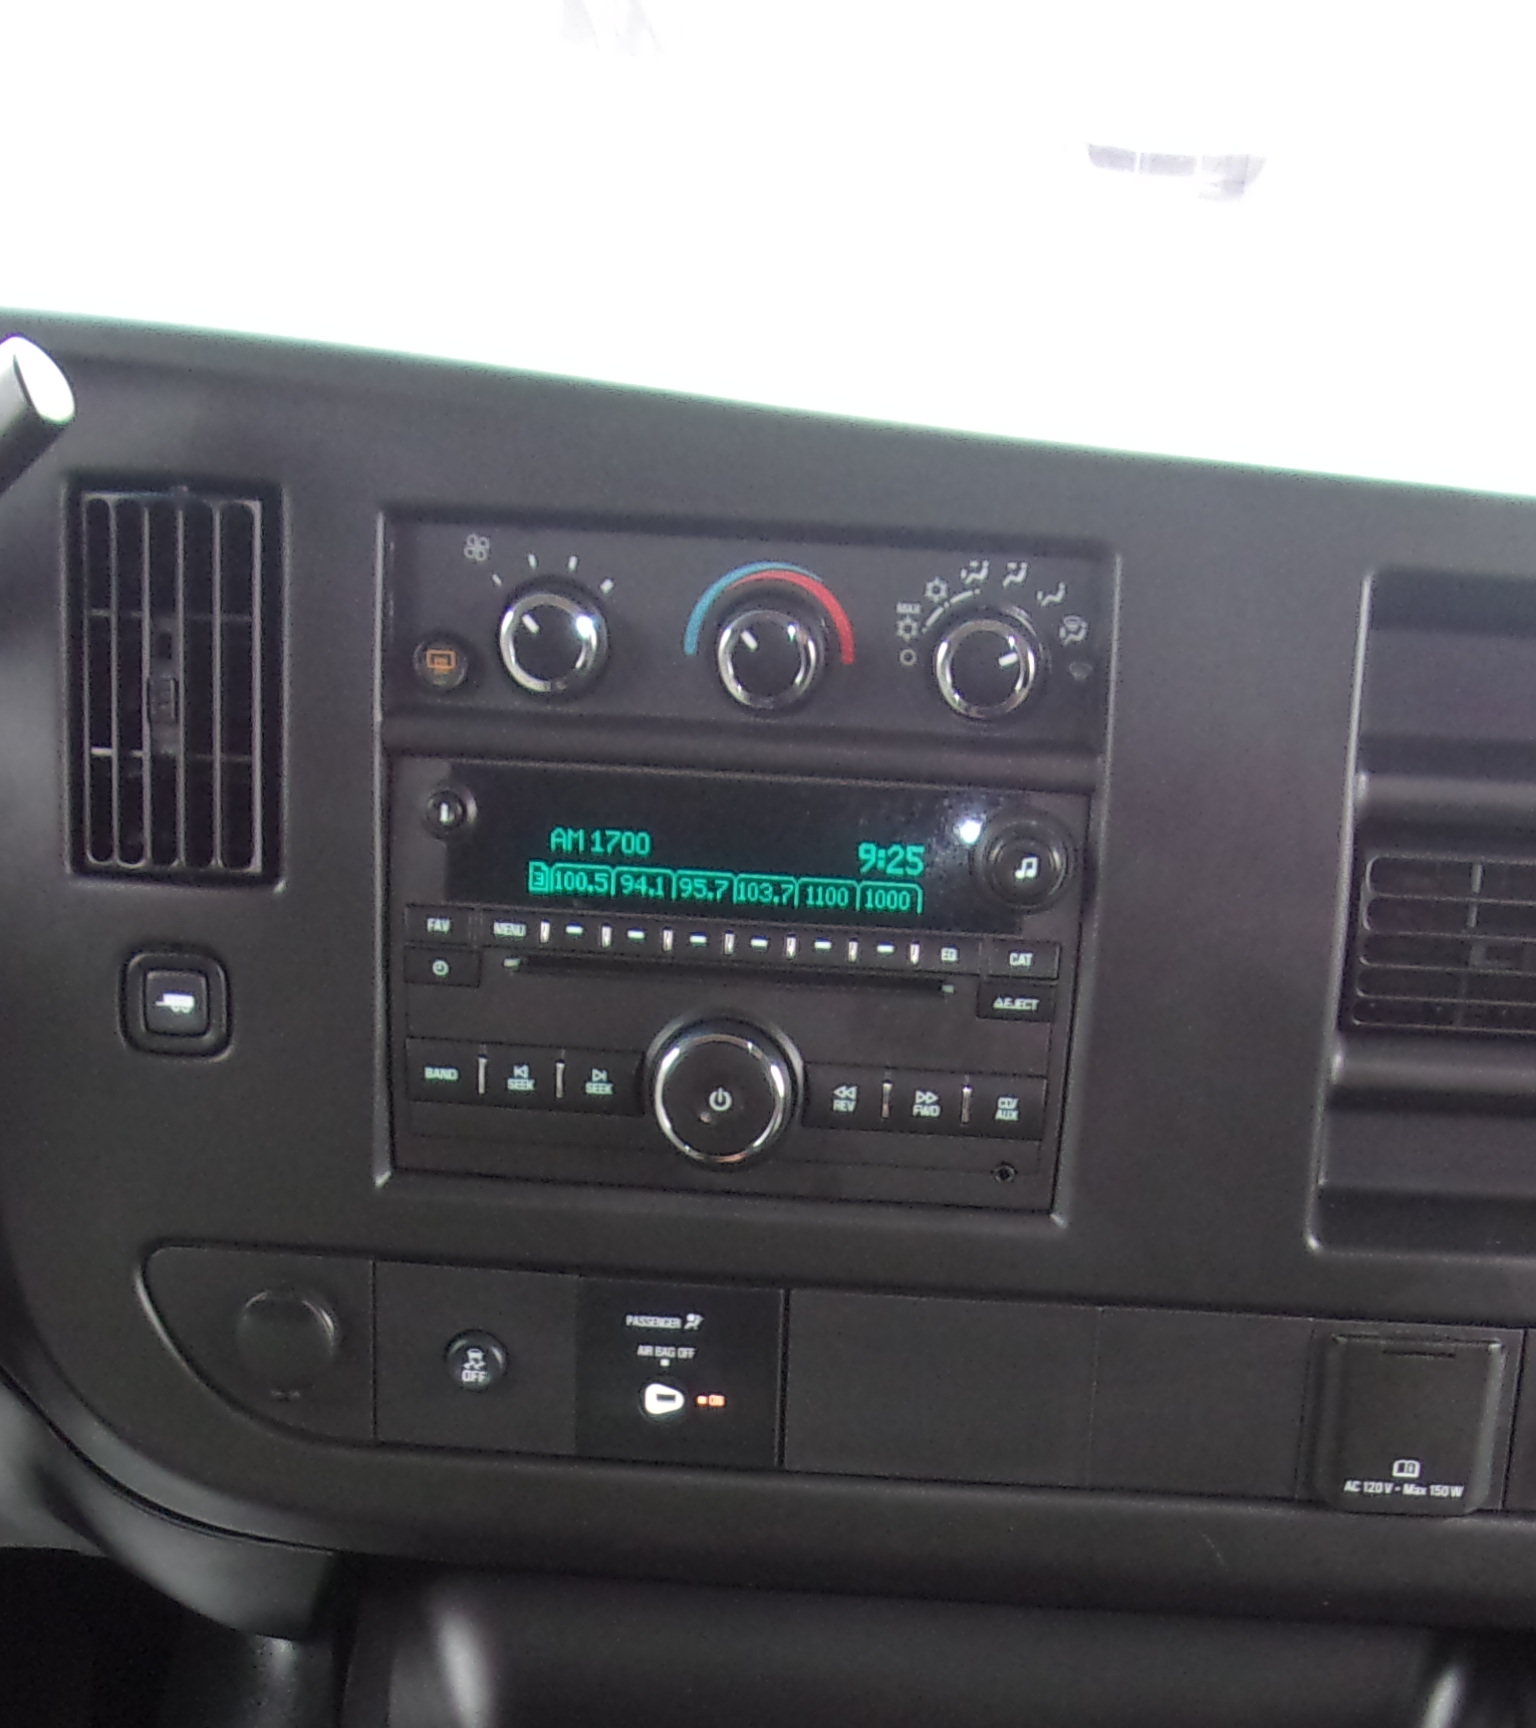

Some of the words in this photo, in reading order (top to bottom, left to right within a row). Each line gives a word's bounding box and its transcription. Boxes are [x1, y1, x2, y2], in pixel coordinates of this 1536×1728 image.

[550, 827, 584, 854] AM
[591, 829, 651, 857] 1700
[858, 842, 924, 876] 9:25
[554, 870, 609, 894] 100.5
[620, 873, 664, 896] 94.1
[678, 877, 729, 903] 95.7
[738, 880, 794, 906] 103.7
[806, 884, 849, 907] 1100
[865, 888, 910, 911] 1000
[427, 917, 451, 934] FAV
[493, 920, 527, 938] MENU
[1009, 952, 1034, 967] CAT
[1002, 997, 1040, 1011] EJECT
[424, 1066, 459, 1081] BAND
[507, 1078, 535, 1091] SEEK
[585, 1082, 614, 1095] SEEK
[833, 1099, 857, 1113] REV
[912, 1104, 941, 1118] FWD
[995, 1109, 1019, 1121] AUX
[625, 1314, 682, 1329] PASSENGER
[637, 1345, 654, 1357] AIR
[655, 1346, 676, 1358] BAG
[677, 1347, 696, 1359] OFF
[462, 1370, 488, 1383] OFF
[1344, 1480, 1362, 1492] AC
[1403, 1483, 1427, 1496] Max
